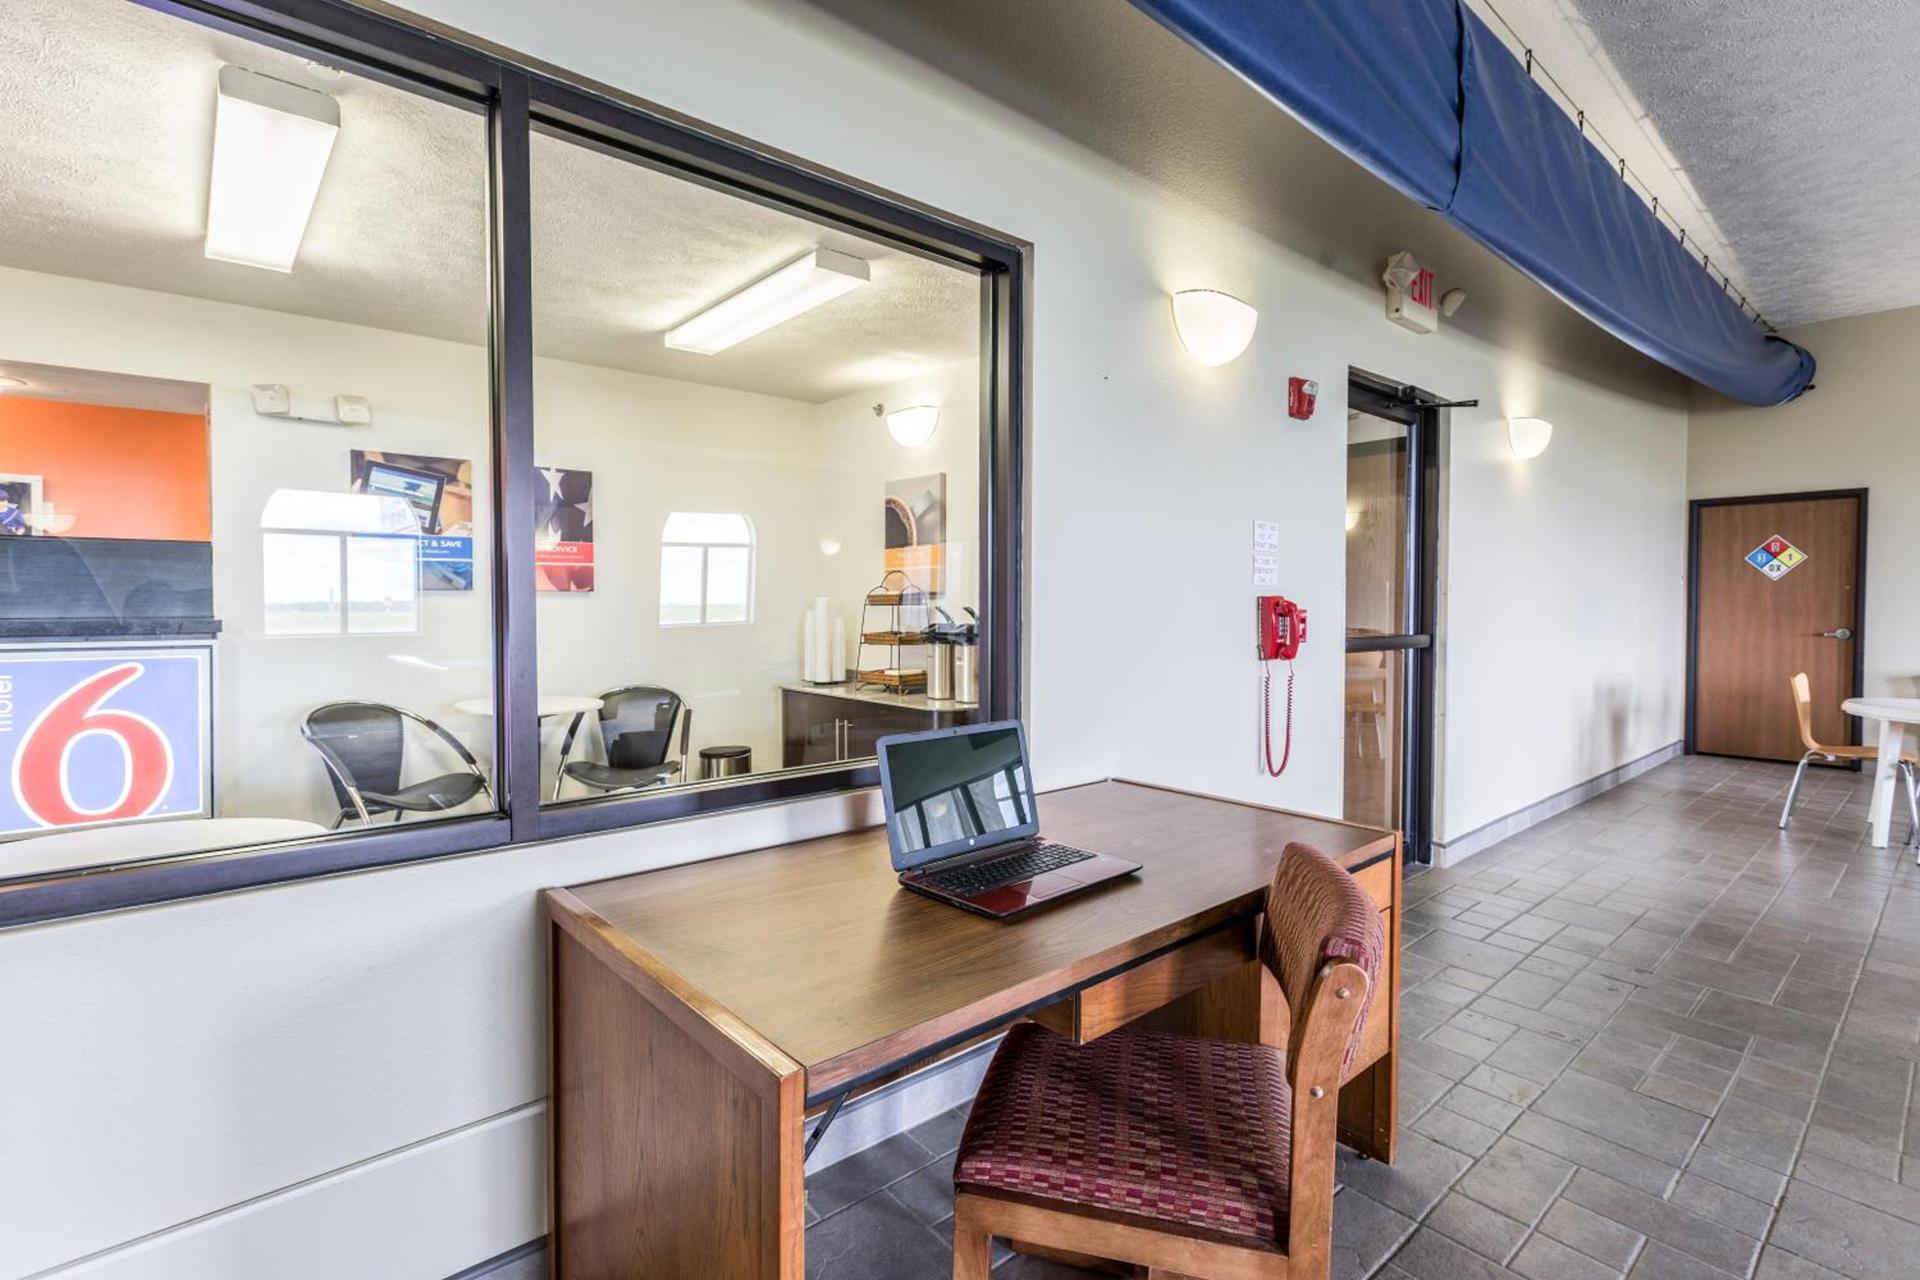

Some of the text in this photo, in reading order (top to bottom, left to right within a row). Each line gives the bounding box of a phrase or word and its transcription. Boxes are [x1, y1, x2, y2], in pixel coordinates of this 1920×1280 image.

[1410, 268, 1434, 310] EXIT
[440, 540, 462, 549] SAVE
[12, 662, 174, 827] 6
